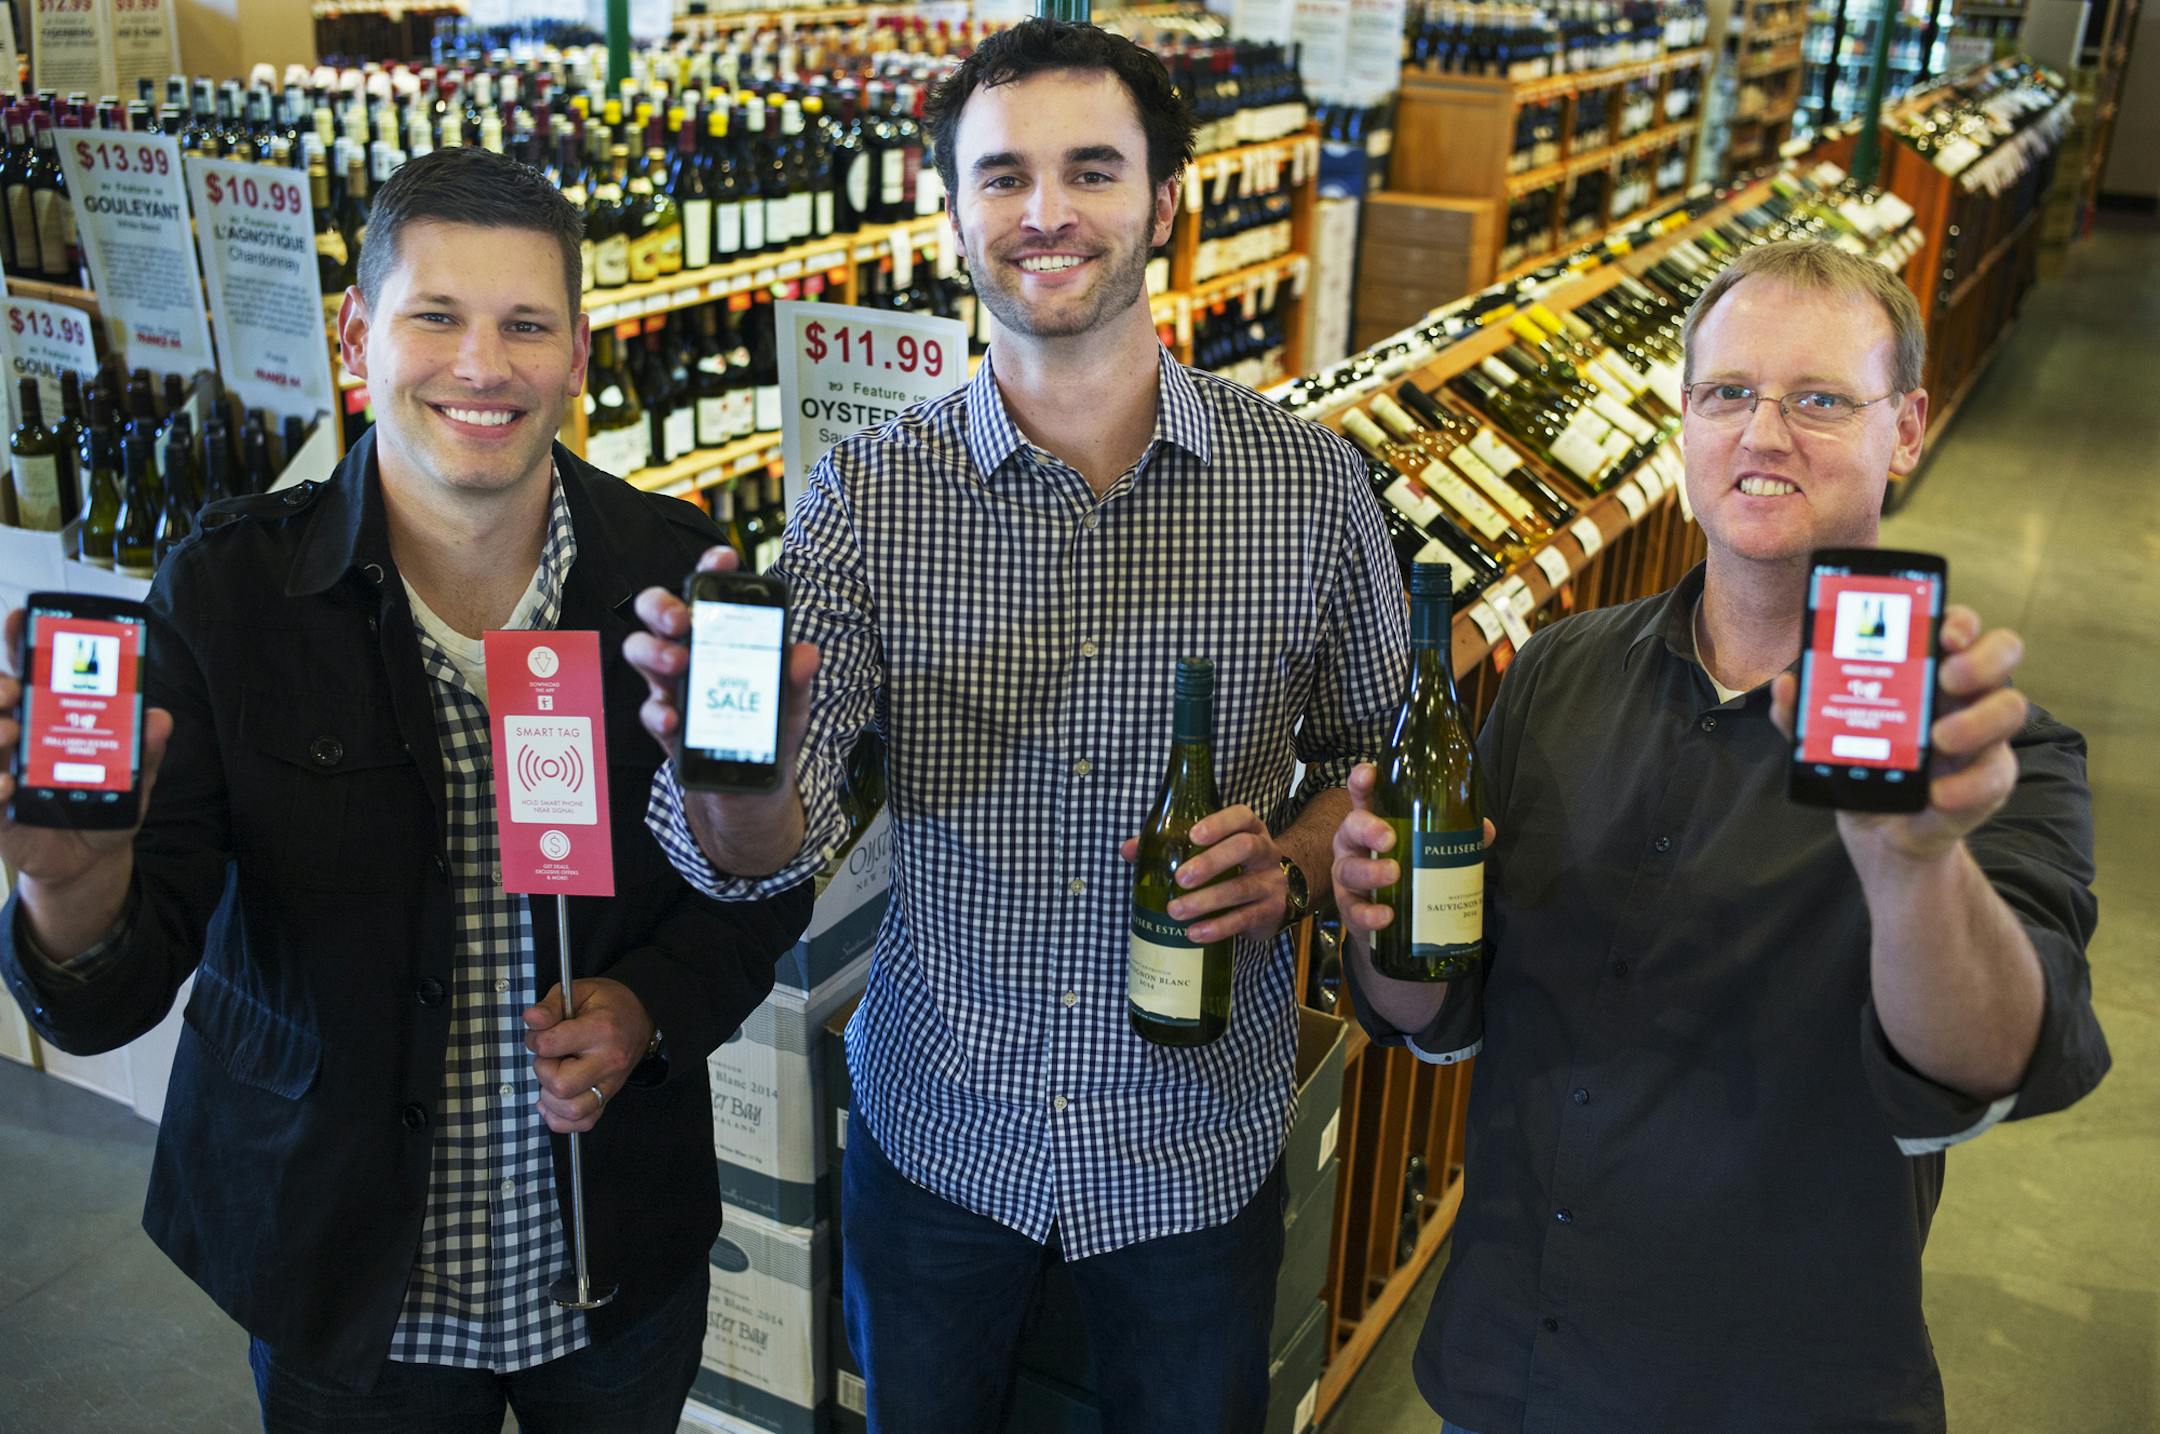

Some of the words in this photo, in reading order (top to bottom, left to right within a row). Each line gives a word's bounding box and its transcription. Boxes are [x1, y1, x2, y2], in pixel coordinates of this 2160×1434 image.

[76, 139, 169, 176] $13.99
[84, 194, 180, 221] GOULEYANT
[205, 171, 302, 215] $10.99
[214, 223, 306, 253] L'AGNOTIQUE
[228, 245, 301, 276] Chardonnay
[9, 306, 85, 347] $13.99
[804, 320, 943, 378] $11.99
[853, 382, 906, 402] Feature
[705, 688, 761, 713] SALE
[516, 726, 553, 738] SMART
[557, 727, 581, 738] TAG
[1424, 843, 1476, 856] PALLISER
[1426, 900, 1478, 912] SAUVIGNON
[1155, 924, 1189, 938] ESTAT
[1159, 976, 1191, 988] BLANC
[715, 1070, 747, 1090] Blanc
[751, 1081, 779, 1100] 2014
[730, 1095, 762, 1126] Bay
[723, 1295, 753, 1316] Blanc
[758, 1309, 784, 1327] 2014
[738, 1320, 769, 1350] Bay
